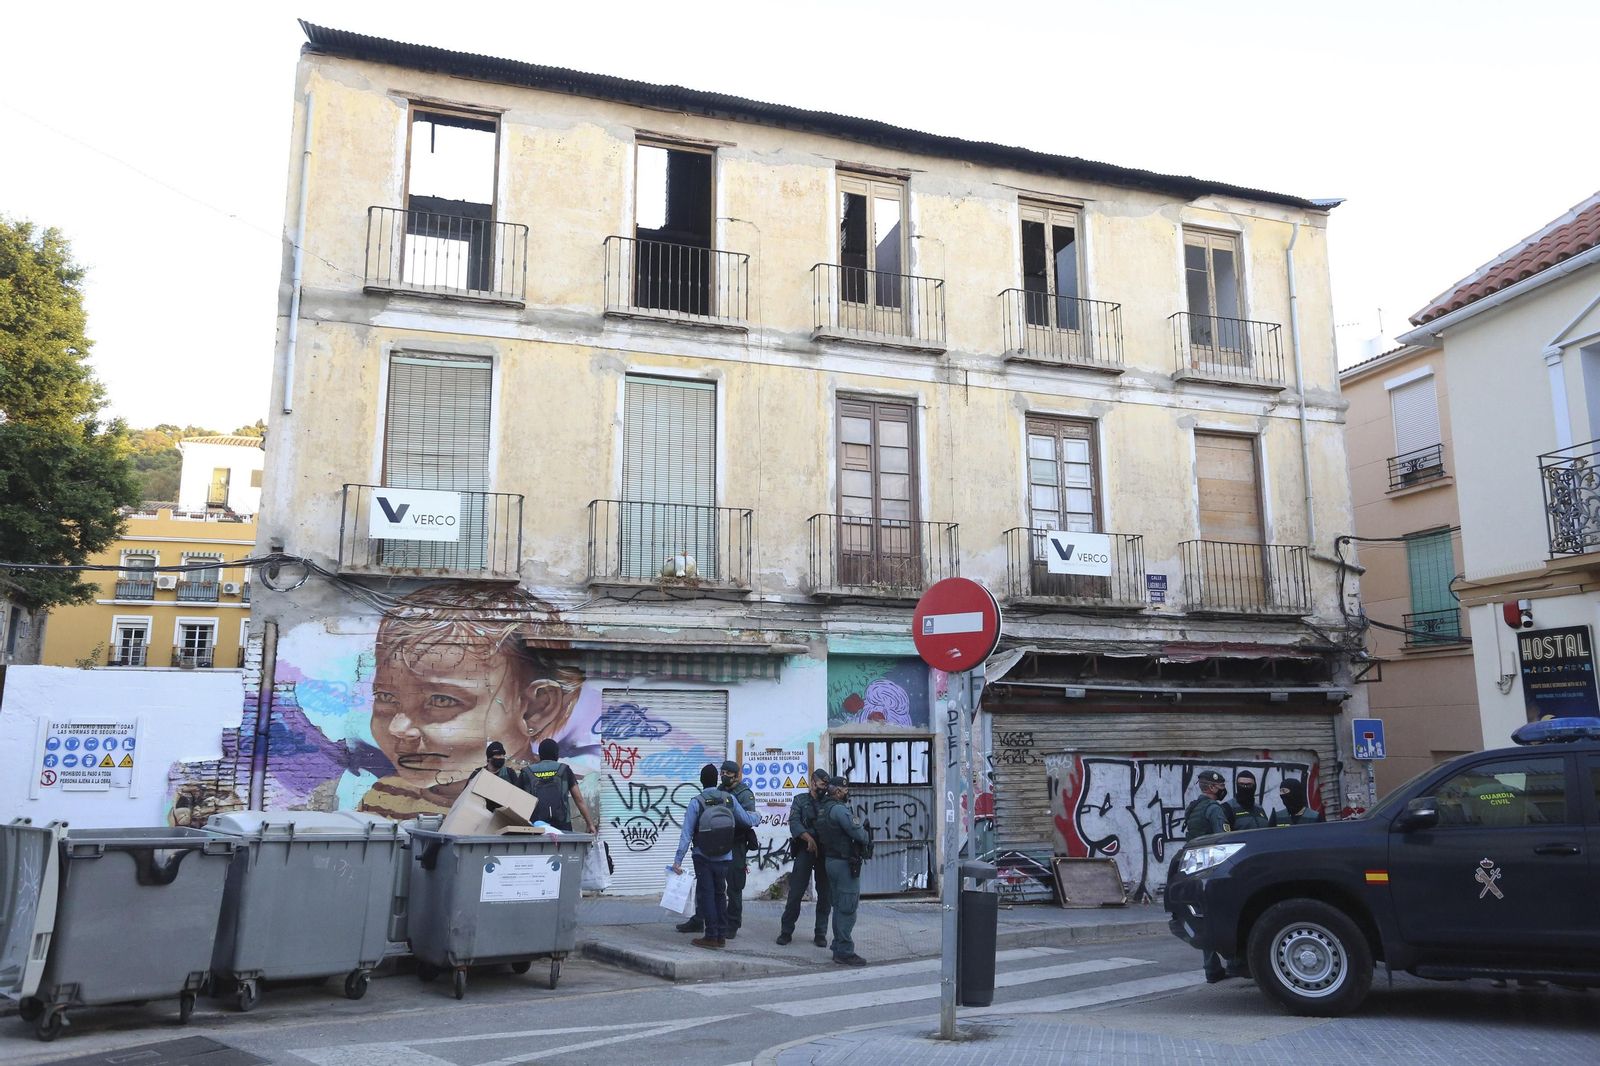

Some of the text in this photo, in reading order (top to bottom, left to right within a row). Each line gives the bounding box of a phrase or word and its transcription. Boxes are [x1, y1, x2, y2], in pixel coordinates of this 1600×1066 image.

[412, 514, 456, 526] VERCO
[1077, 552, 1108, 564] VERCO
[1521, 634, 1590, 660] HOSTAL
[1480, 792, 1515, 800] GUARDIA
